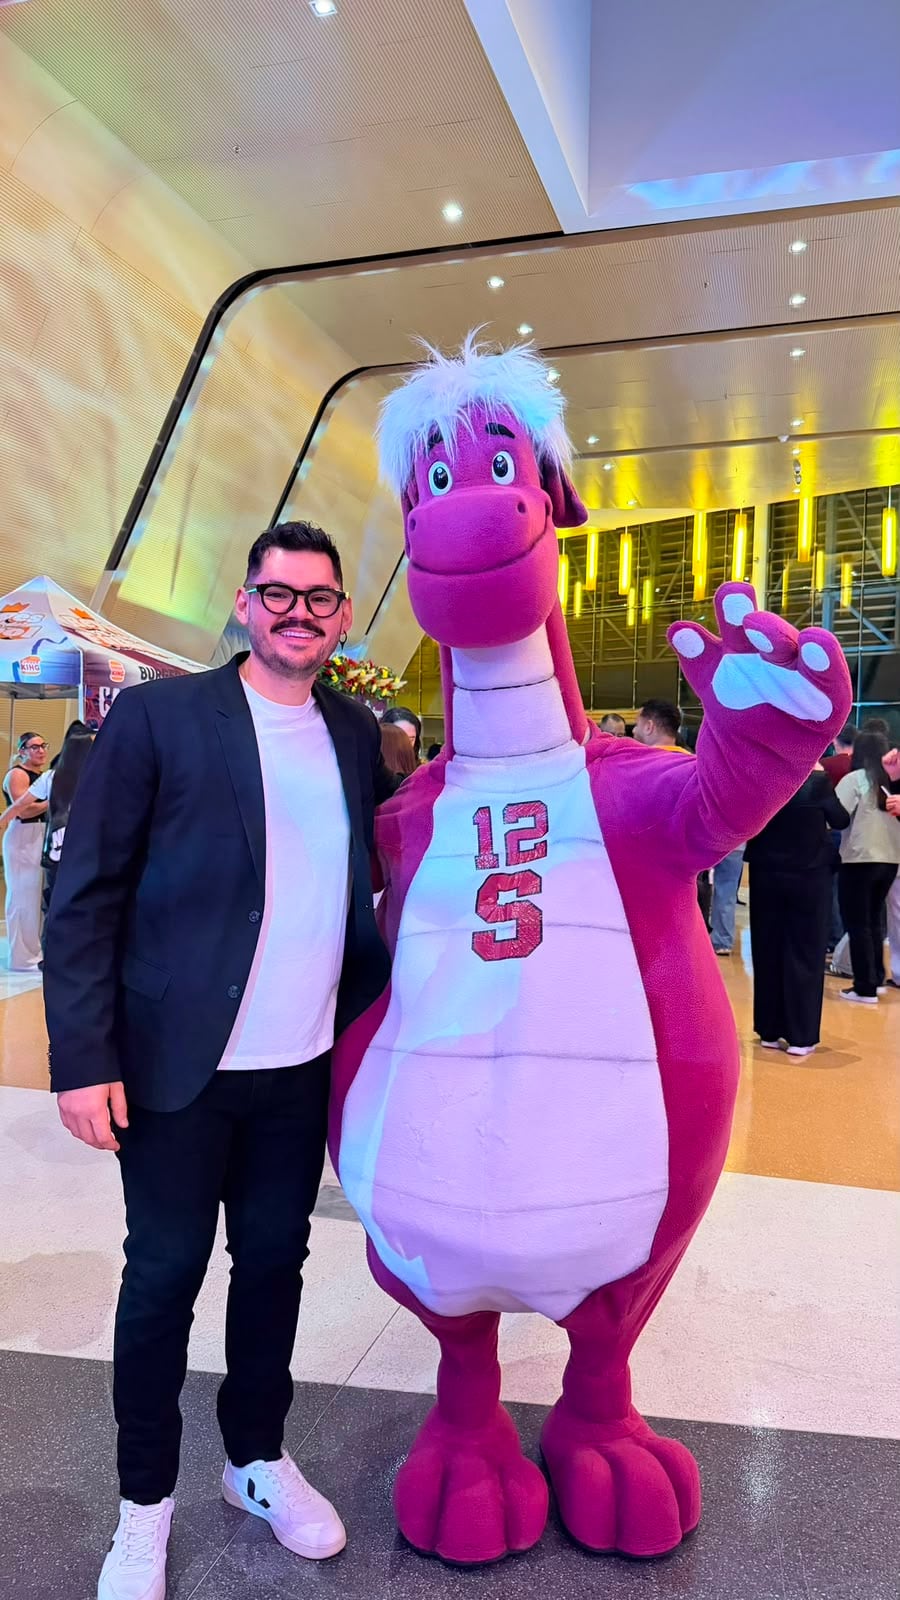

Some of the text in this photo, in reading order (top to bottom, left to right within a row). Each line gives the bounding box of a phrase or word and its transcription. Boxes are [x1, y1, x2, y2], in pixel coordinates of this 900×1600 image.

[21, 663, 40, 672] KING
[472, 800, 549, 870] 12
[471, 868, 543, 962] S
